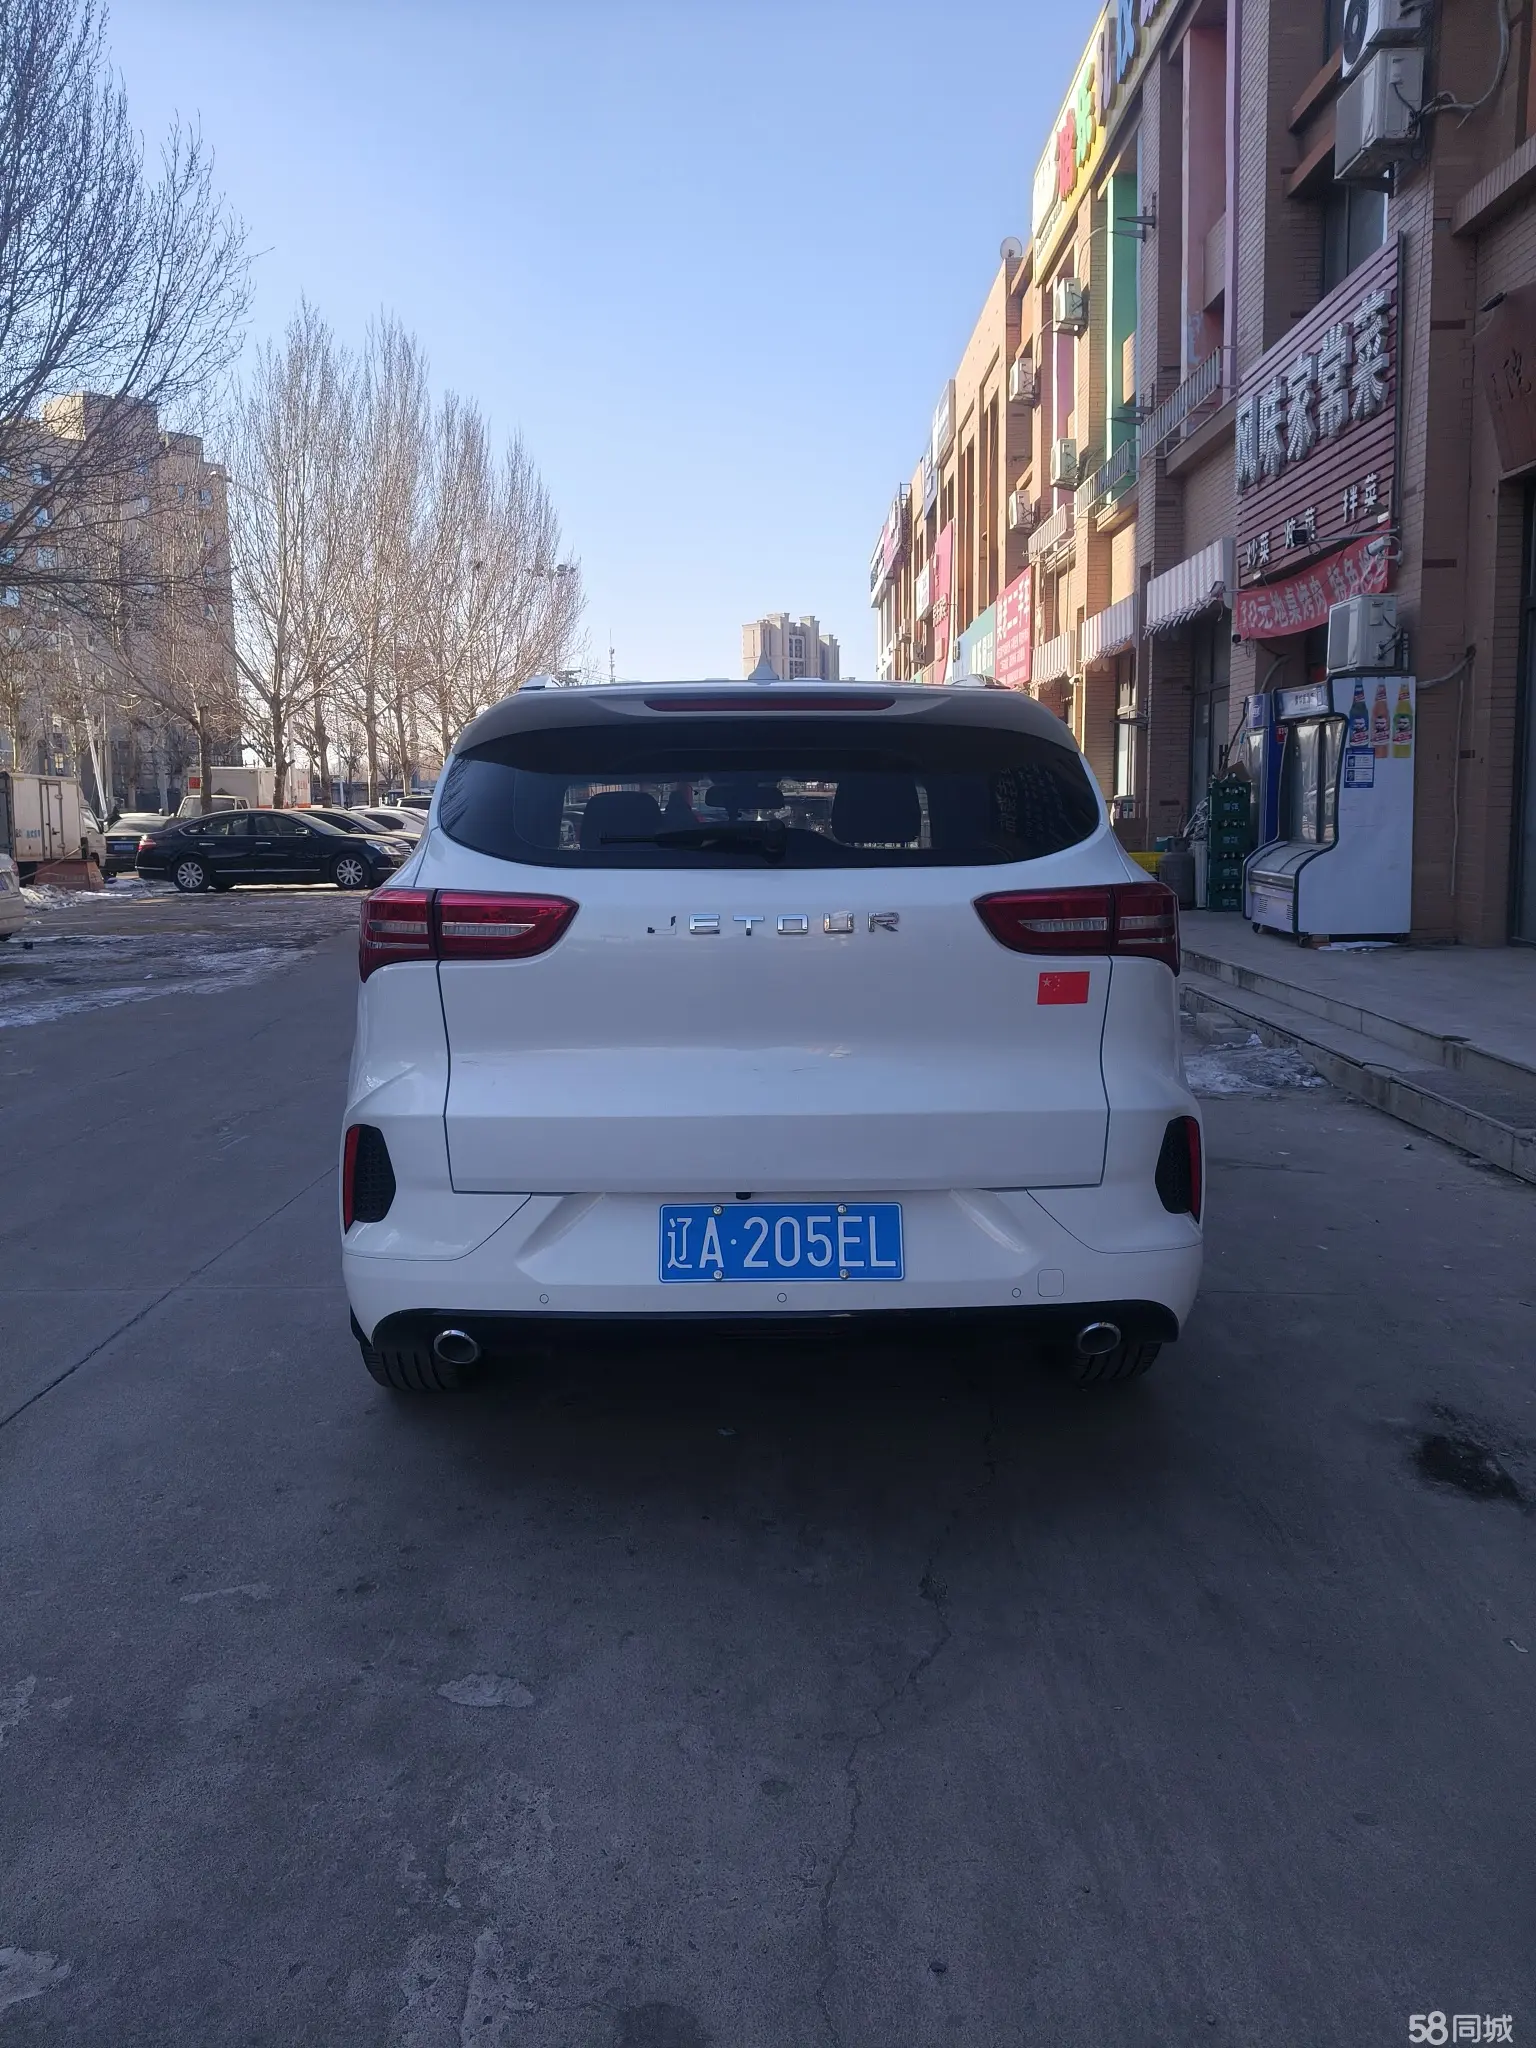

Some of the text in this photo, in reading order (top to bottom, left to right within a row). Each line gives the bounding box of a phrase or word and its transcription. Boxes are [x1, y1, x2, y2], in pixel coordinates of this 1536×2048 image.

[1235, 287, 1390, 494] 风味家常菜
[646, 911, 900, 937] JETOUR
